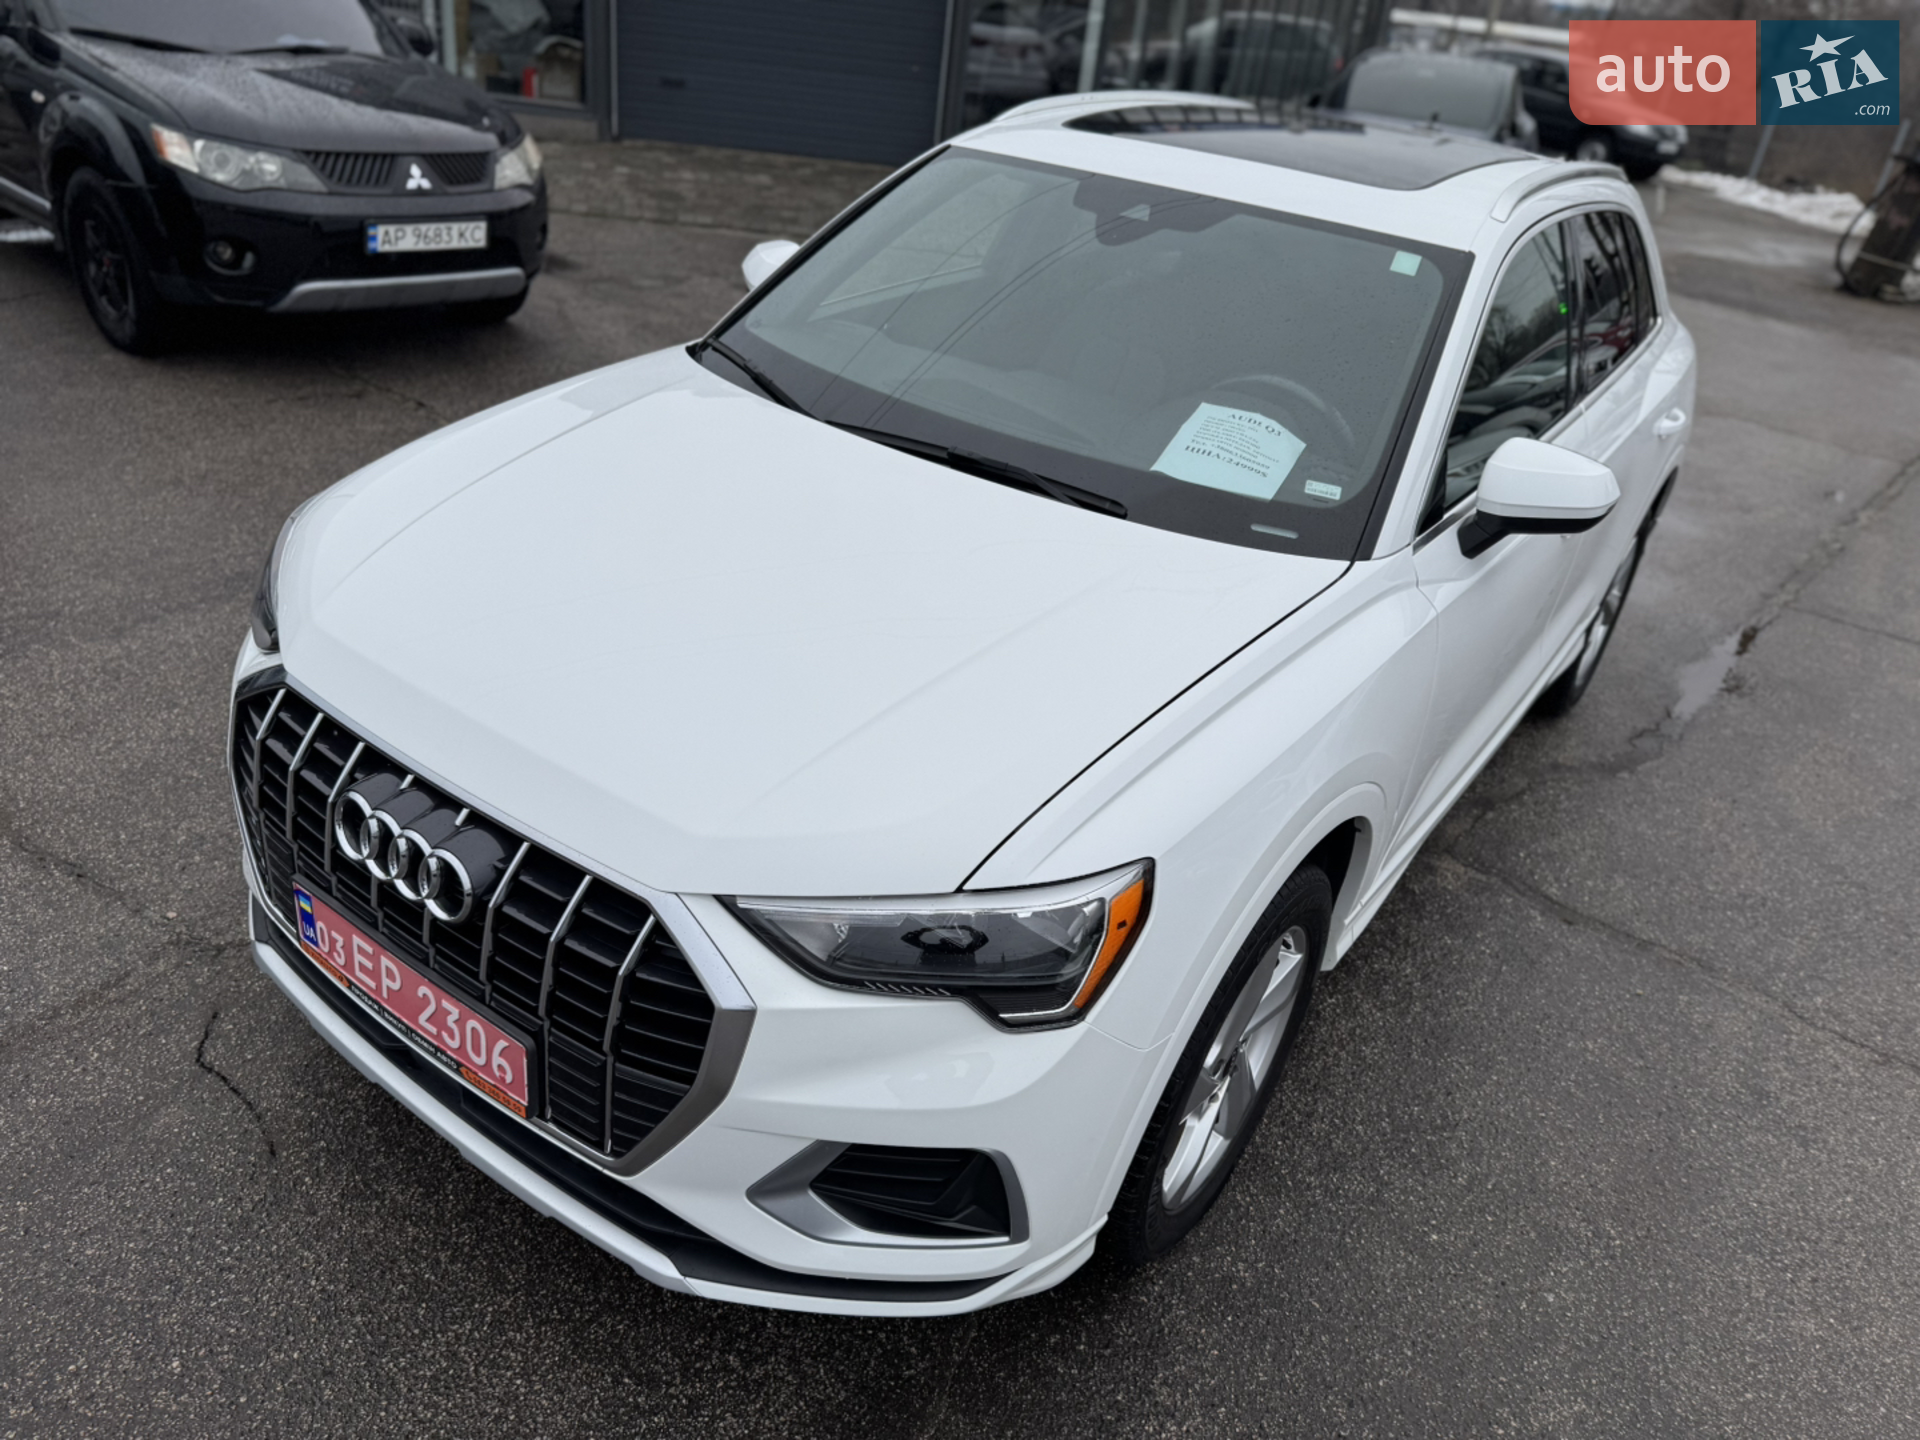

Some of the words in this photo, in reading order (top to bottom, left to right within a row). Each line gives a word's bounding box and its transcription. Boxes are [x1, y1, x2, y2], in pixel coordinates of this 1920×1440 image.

[381, 227, 406, 248] AP
[412, 225, 453, 247] 9683
[457, 224, 483, 245] KC
[1227, 413, 1263, 428] AUDI
[1264, 424, 1282, 437] Q3
[303, 921, 317, 942] UA
[416, 985, 513, 1085] 2306
